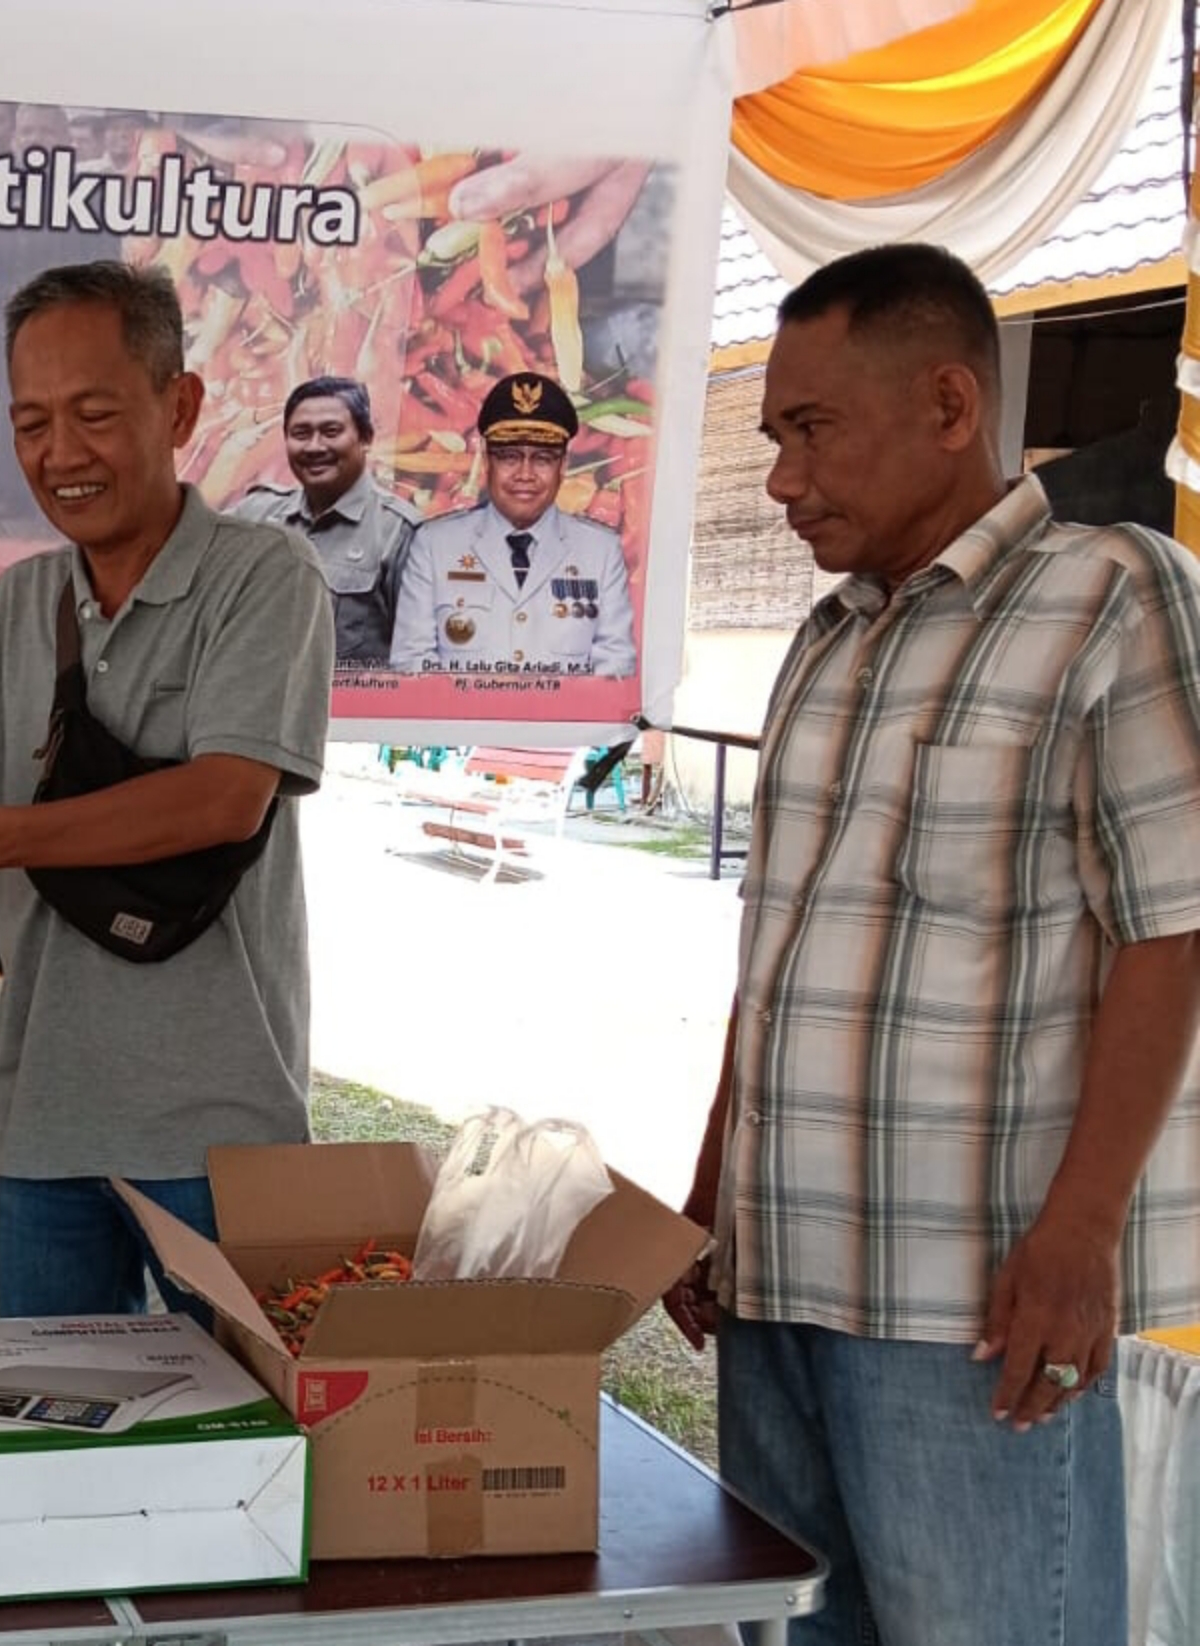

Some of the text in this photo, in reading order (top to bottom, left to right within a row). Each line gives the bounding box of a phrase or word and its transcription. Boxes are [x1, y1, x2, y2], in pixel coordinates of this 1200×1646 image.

[466, 659, 492, 672] Lalu
[474, 679, 532, 691] Gubernur
[535, 679, 561, 691] NTB
[415, 1429, 432, 1444] Isi
[367, 1474, 472, 1492] 12 X 1 Liter
